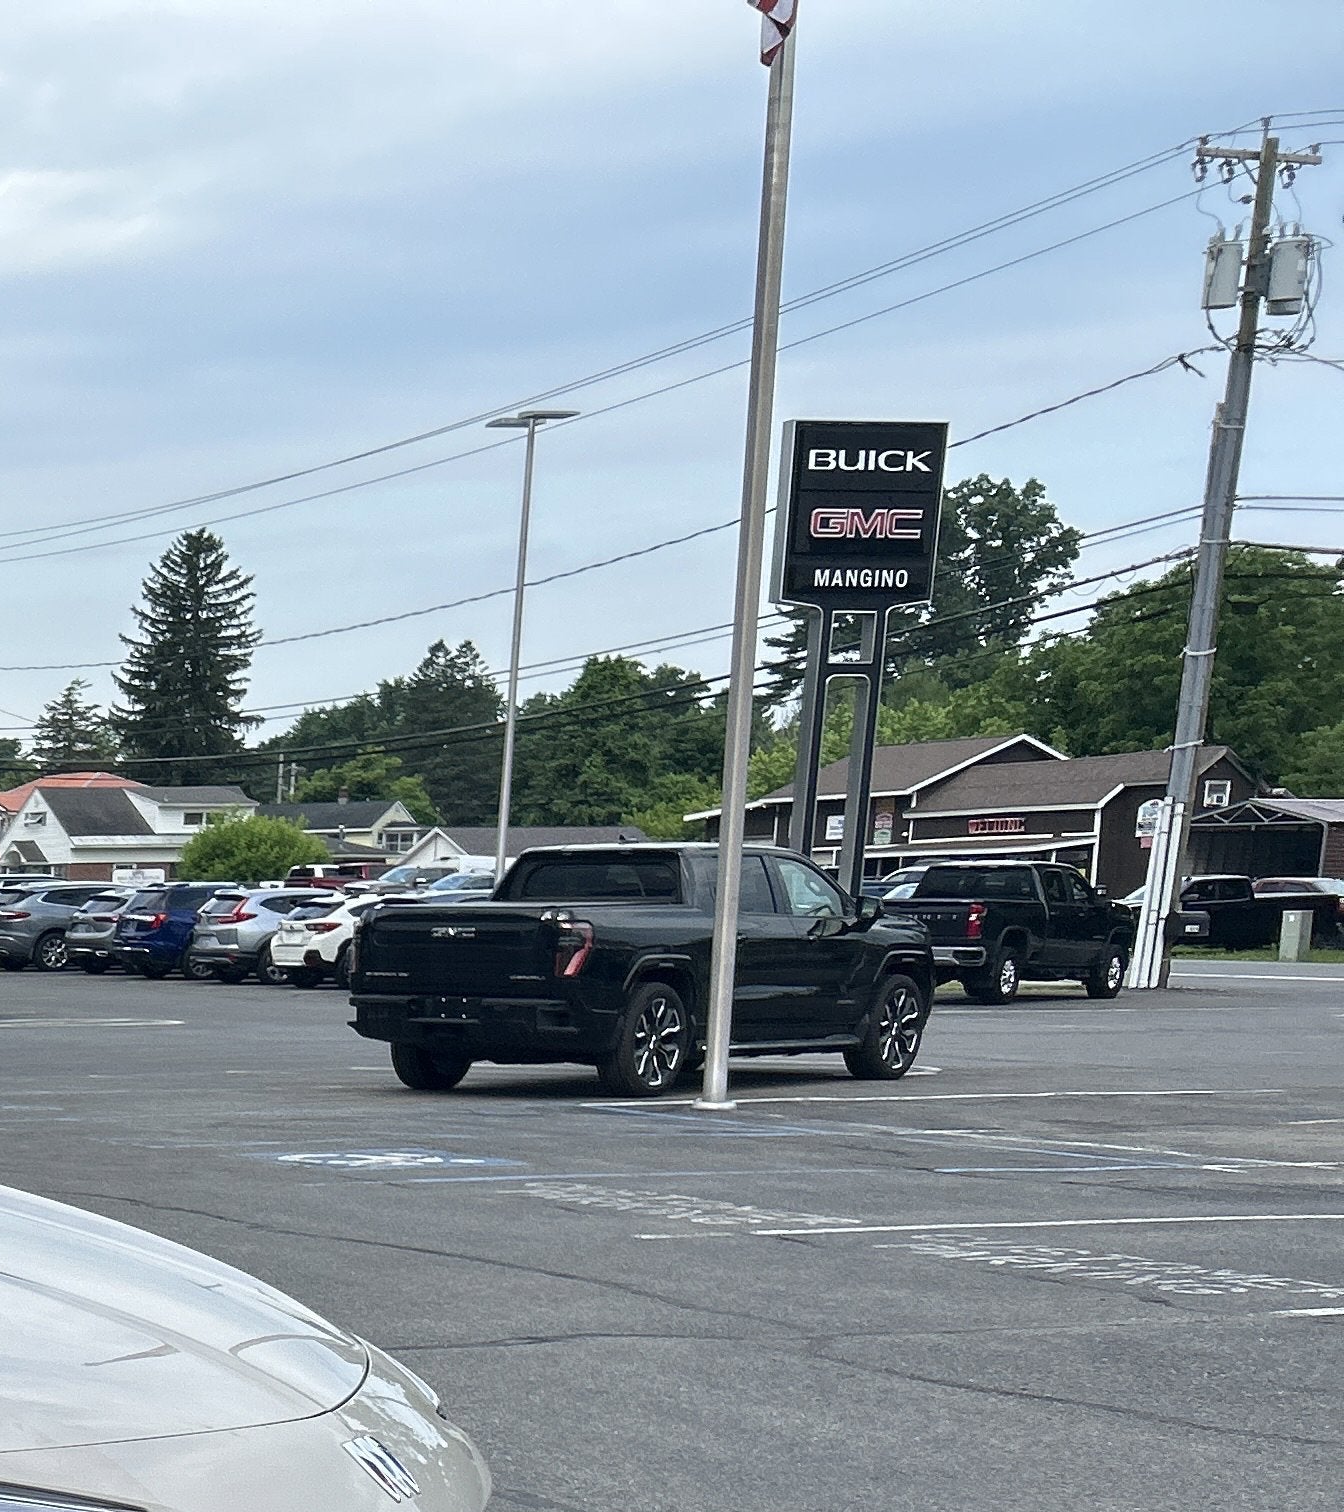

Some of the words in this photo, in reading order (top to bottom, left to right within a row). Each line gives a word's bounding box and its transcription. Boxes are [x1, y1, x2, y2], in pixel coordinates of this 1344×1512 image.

[808, 449, 933, 472] BUICK
[810, 508, 924, 539] GMC
[813, 568, 909, 588] MANGINO
